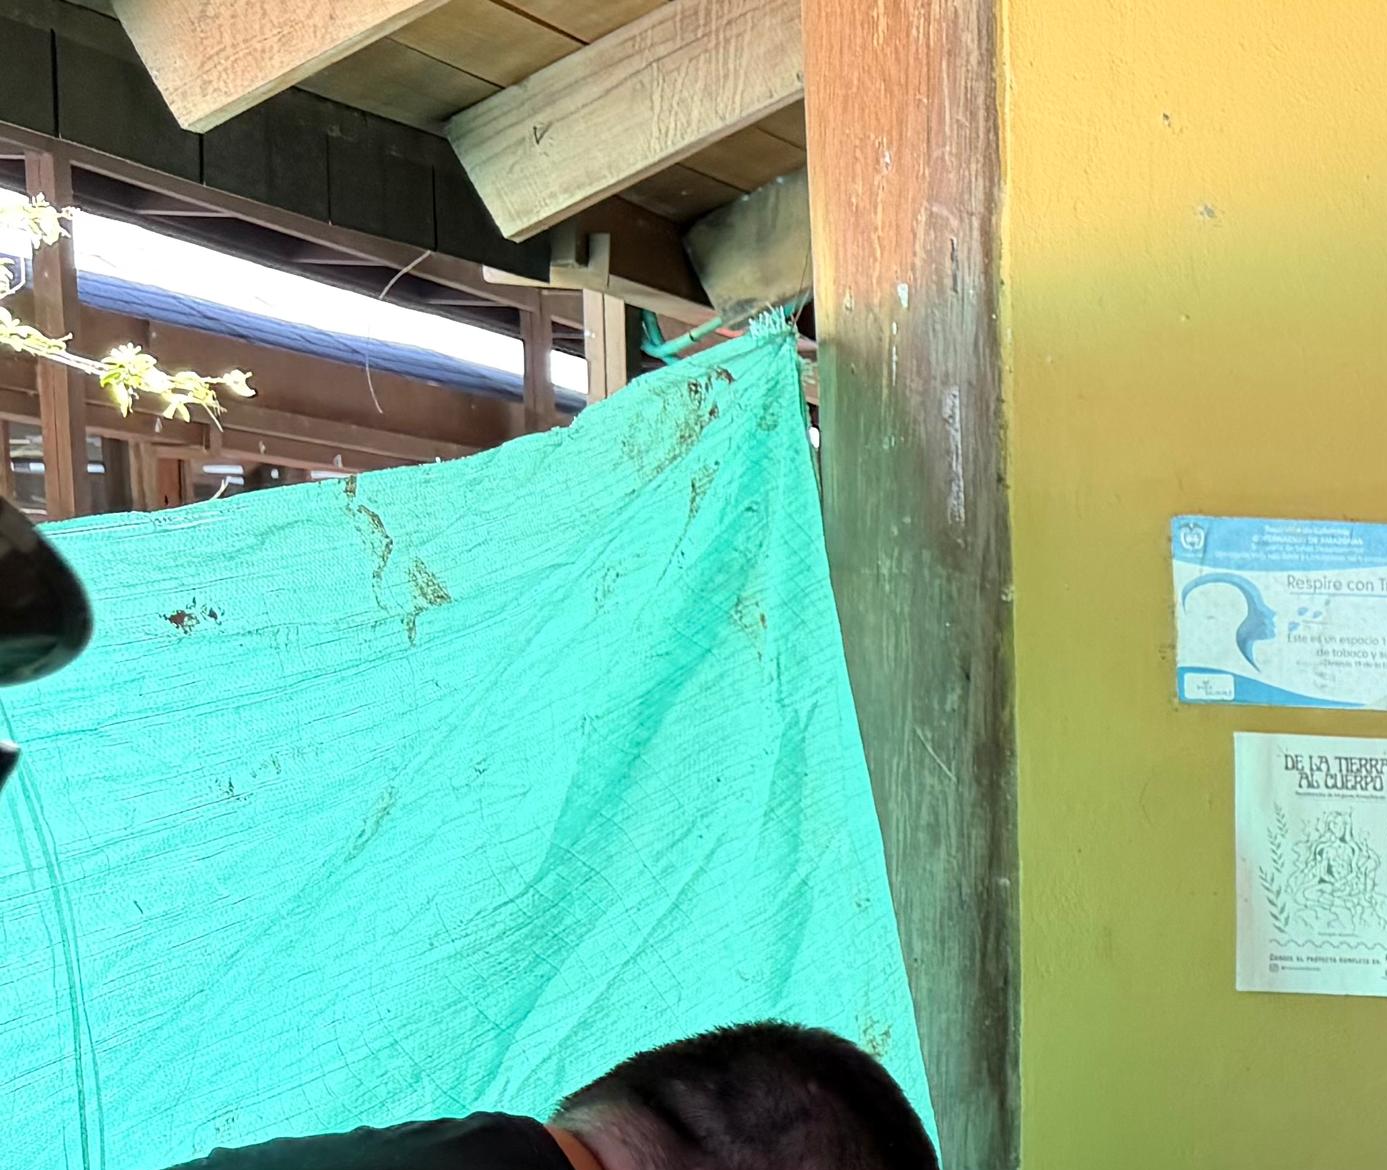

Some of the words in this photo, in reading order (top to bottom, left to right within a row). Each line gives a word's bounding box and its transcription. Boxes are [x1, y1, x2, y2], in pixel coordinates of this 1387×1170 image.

[1288, 575, 1341, 592] Respire
[1346, 581, 1374, 590] con
[1284, 754, 1305, 771] DE
[1308, 755, 1330, 772] LA
[1298, 773, 1321, 789] AL
[1324, 774, 1384, 791] CUERPO
